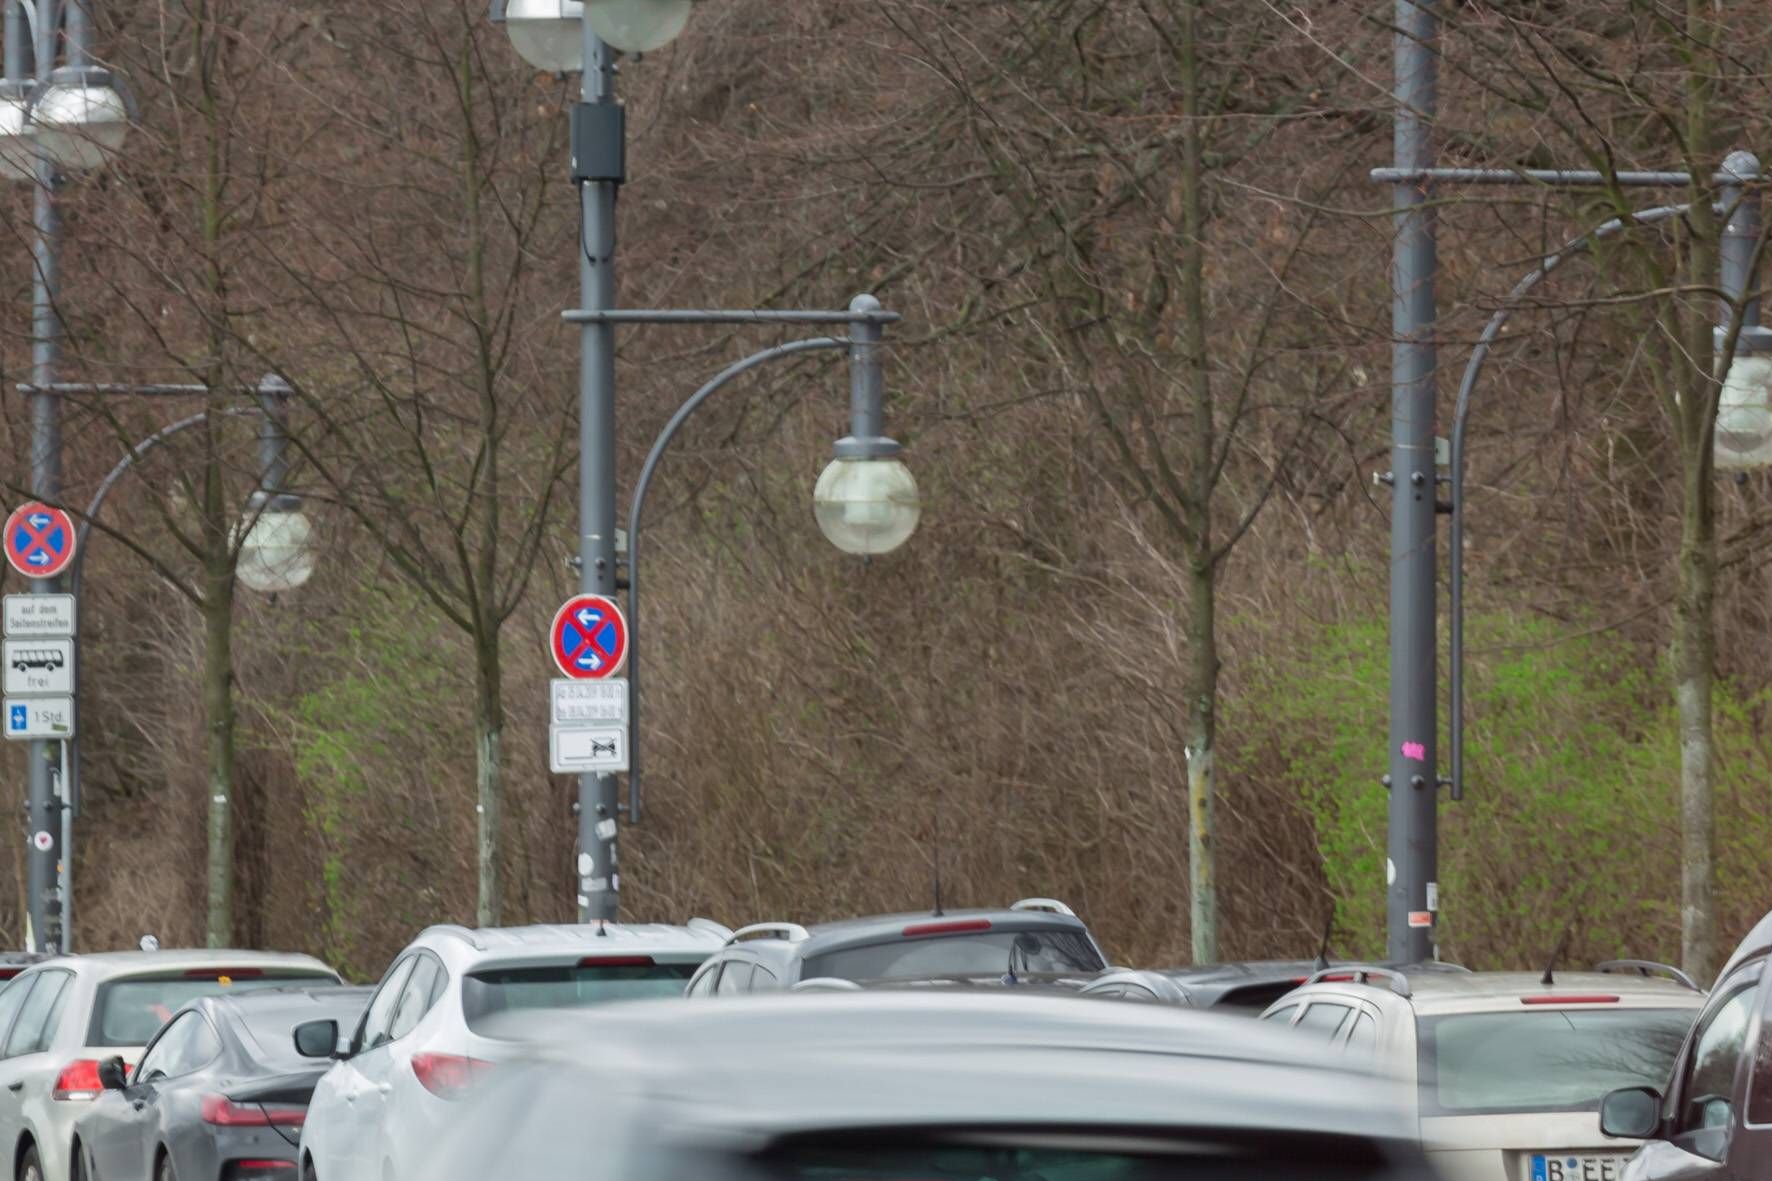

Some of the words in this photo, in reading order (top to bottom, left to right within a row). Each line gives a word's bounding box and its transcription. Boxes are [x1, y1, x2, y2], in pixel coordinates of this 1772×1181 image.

[21, 605, 34, 615] auf
[40, 605, 57, 615] dem
[10, 616, 69, 629] Seitenstreifen
[27, 675, 49, 687] frei
